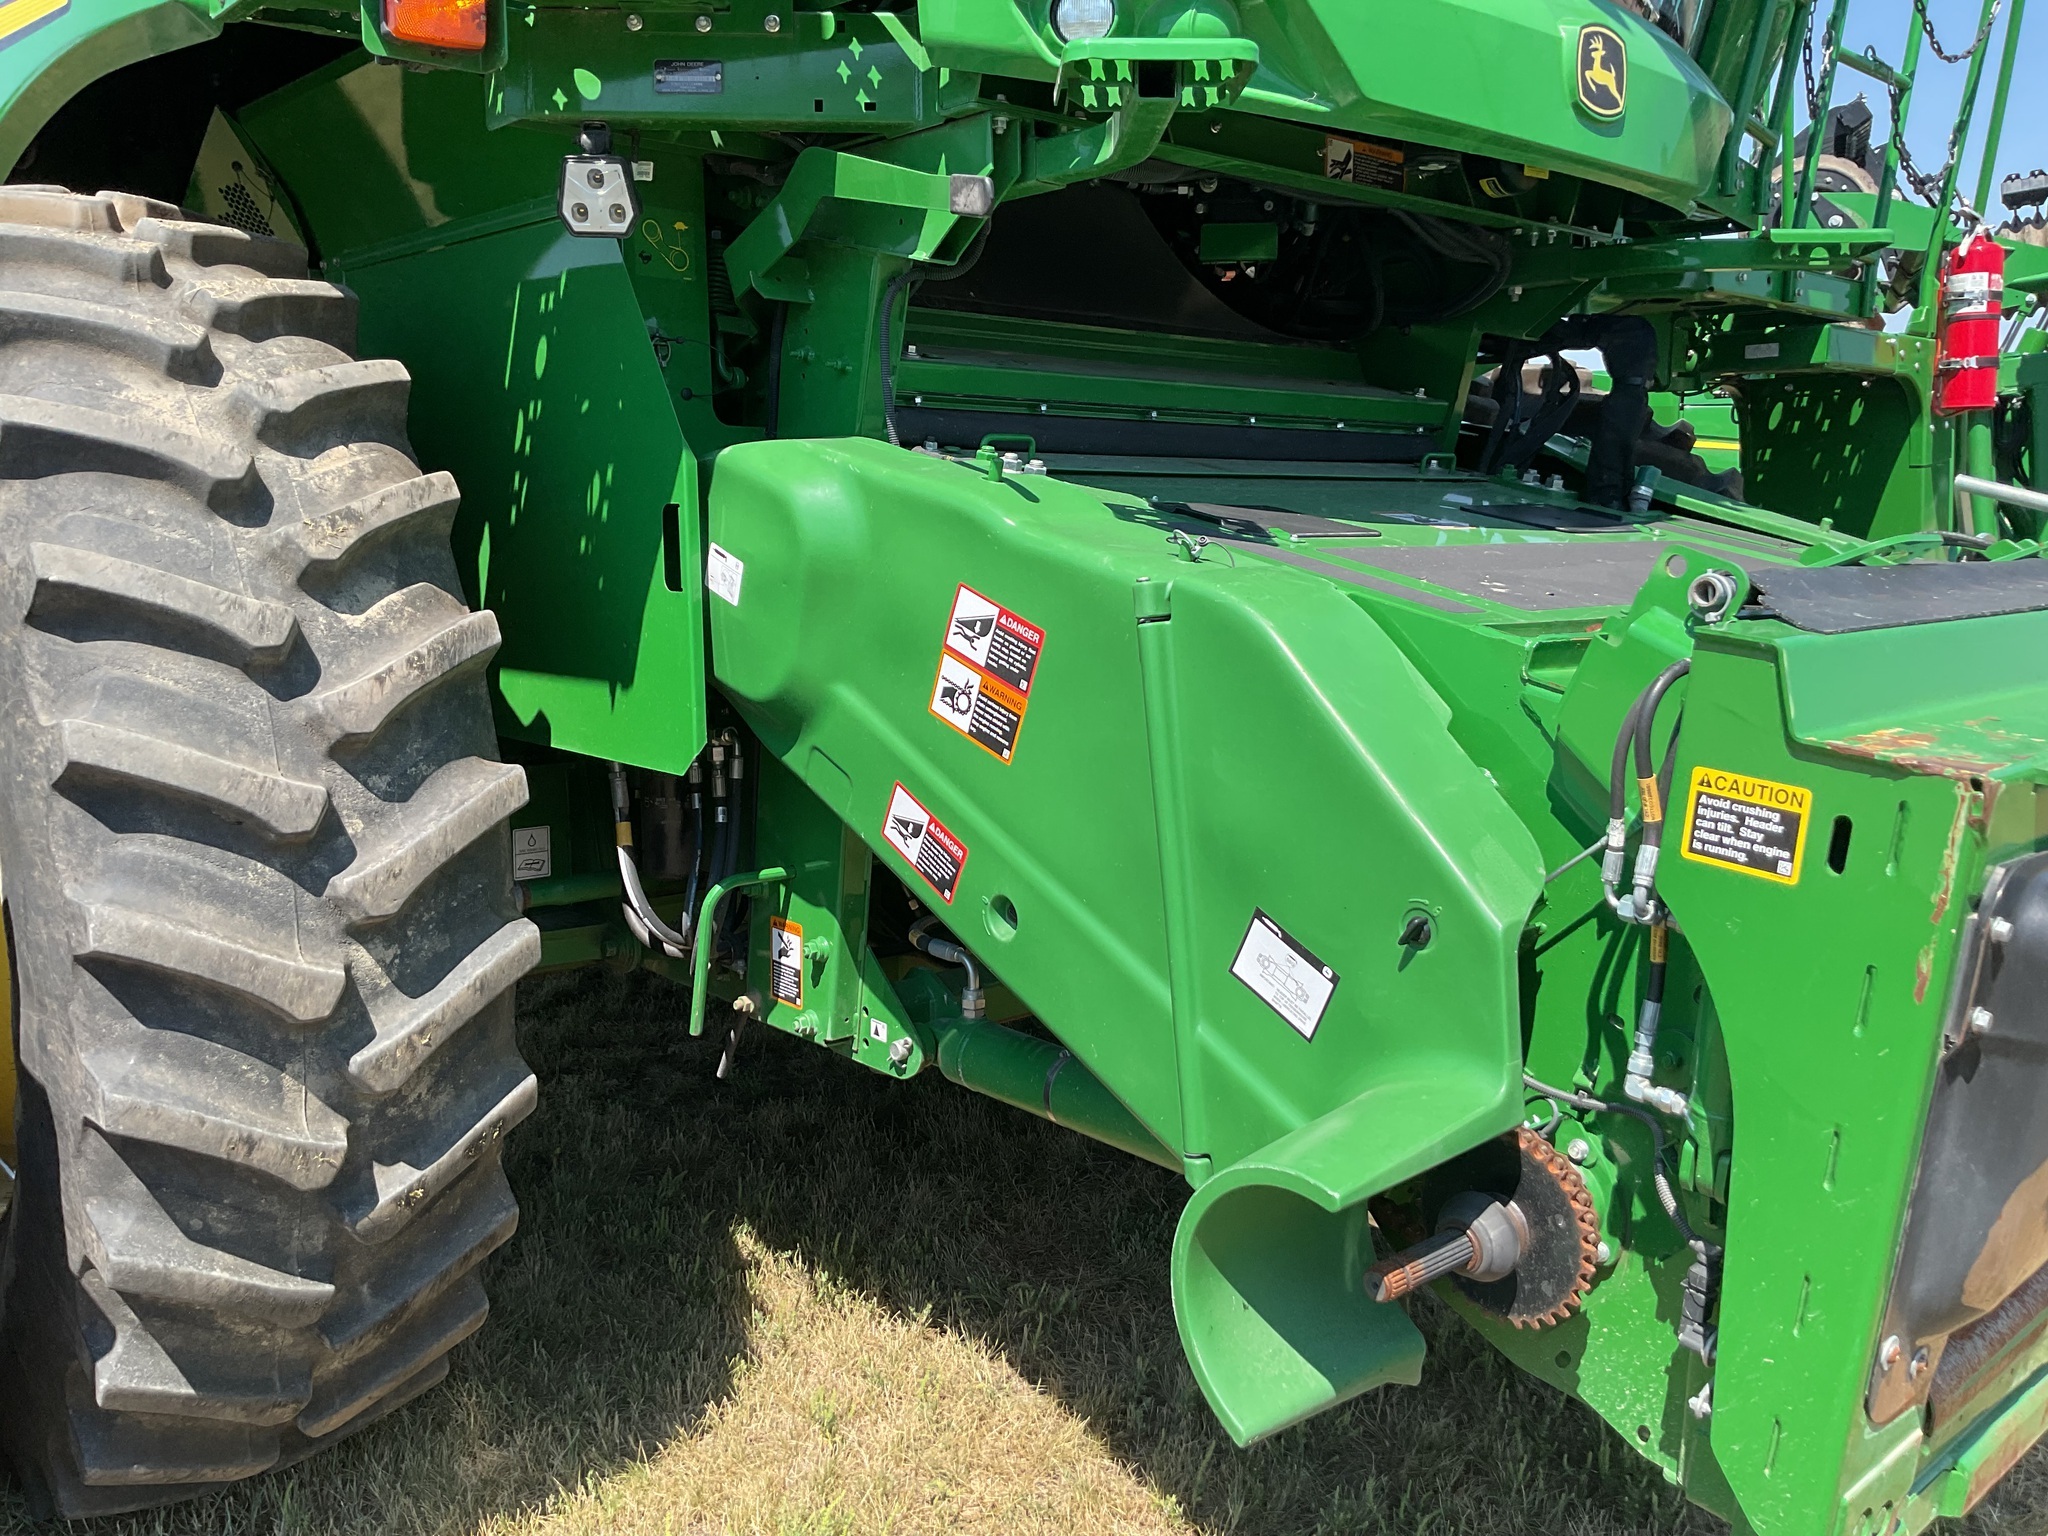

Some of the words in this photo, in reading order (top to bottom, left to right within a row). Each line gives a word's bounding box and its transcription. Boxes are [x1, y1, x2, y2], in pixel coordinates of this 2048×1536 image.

[1005, 617, 1041, 644] DANGER
[988, 683, 1023, 711] WARNING
[1714, 775, 1805, 808] CAUTION
[1697, 806, 1739, 823] injuries.
[1744, 816, 1784, 833] Header
[1699, 794, 1730, 809] Avoid
[1731, 801, 1781, 822] crushing
[933, 827, 964, 859] DANGER
[1693, 829, 1721, 842] clear
[1722, 836, 1751, 849] when
[1752, 843, 1791, 859] engine
[1695, 818, 1715, 830] can
[1717, 822, 1734, 834] tilt.
[1739, 826, 1764, 842] Stay
[1692, 839, 1703, 850] is
[1704, 843, 1748, 862] running.
